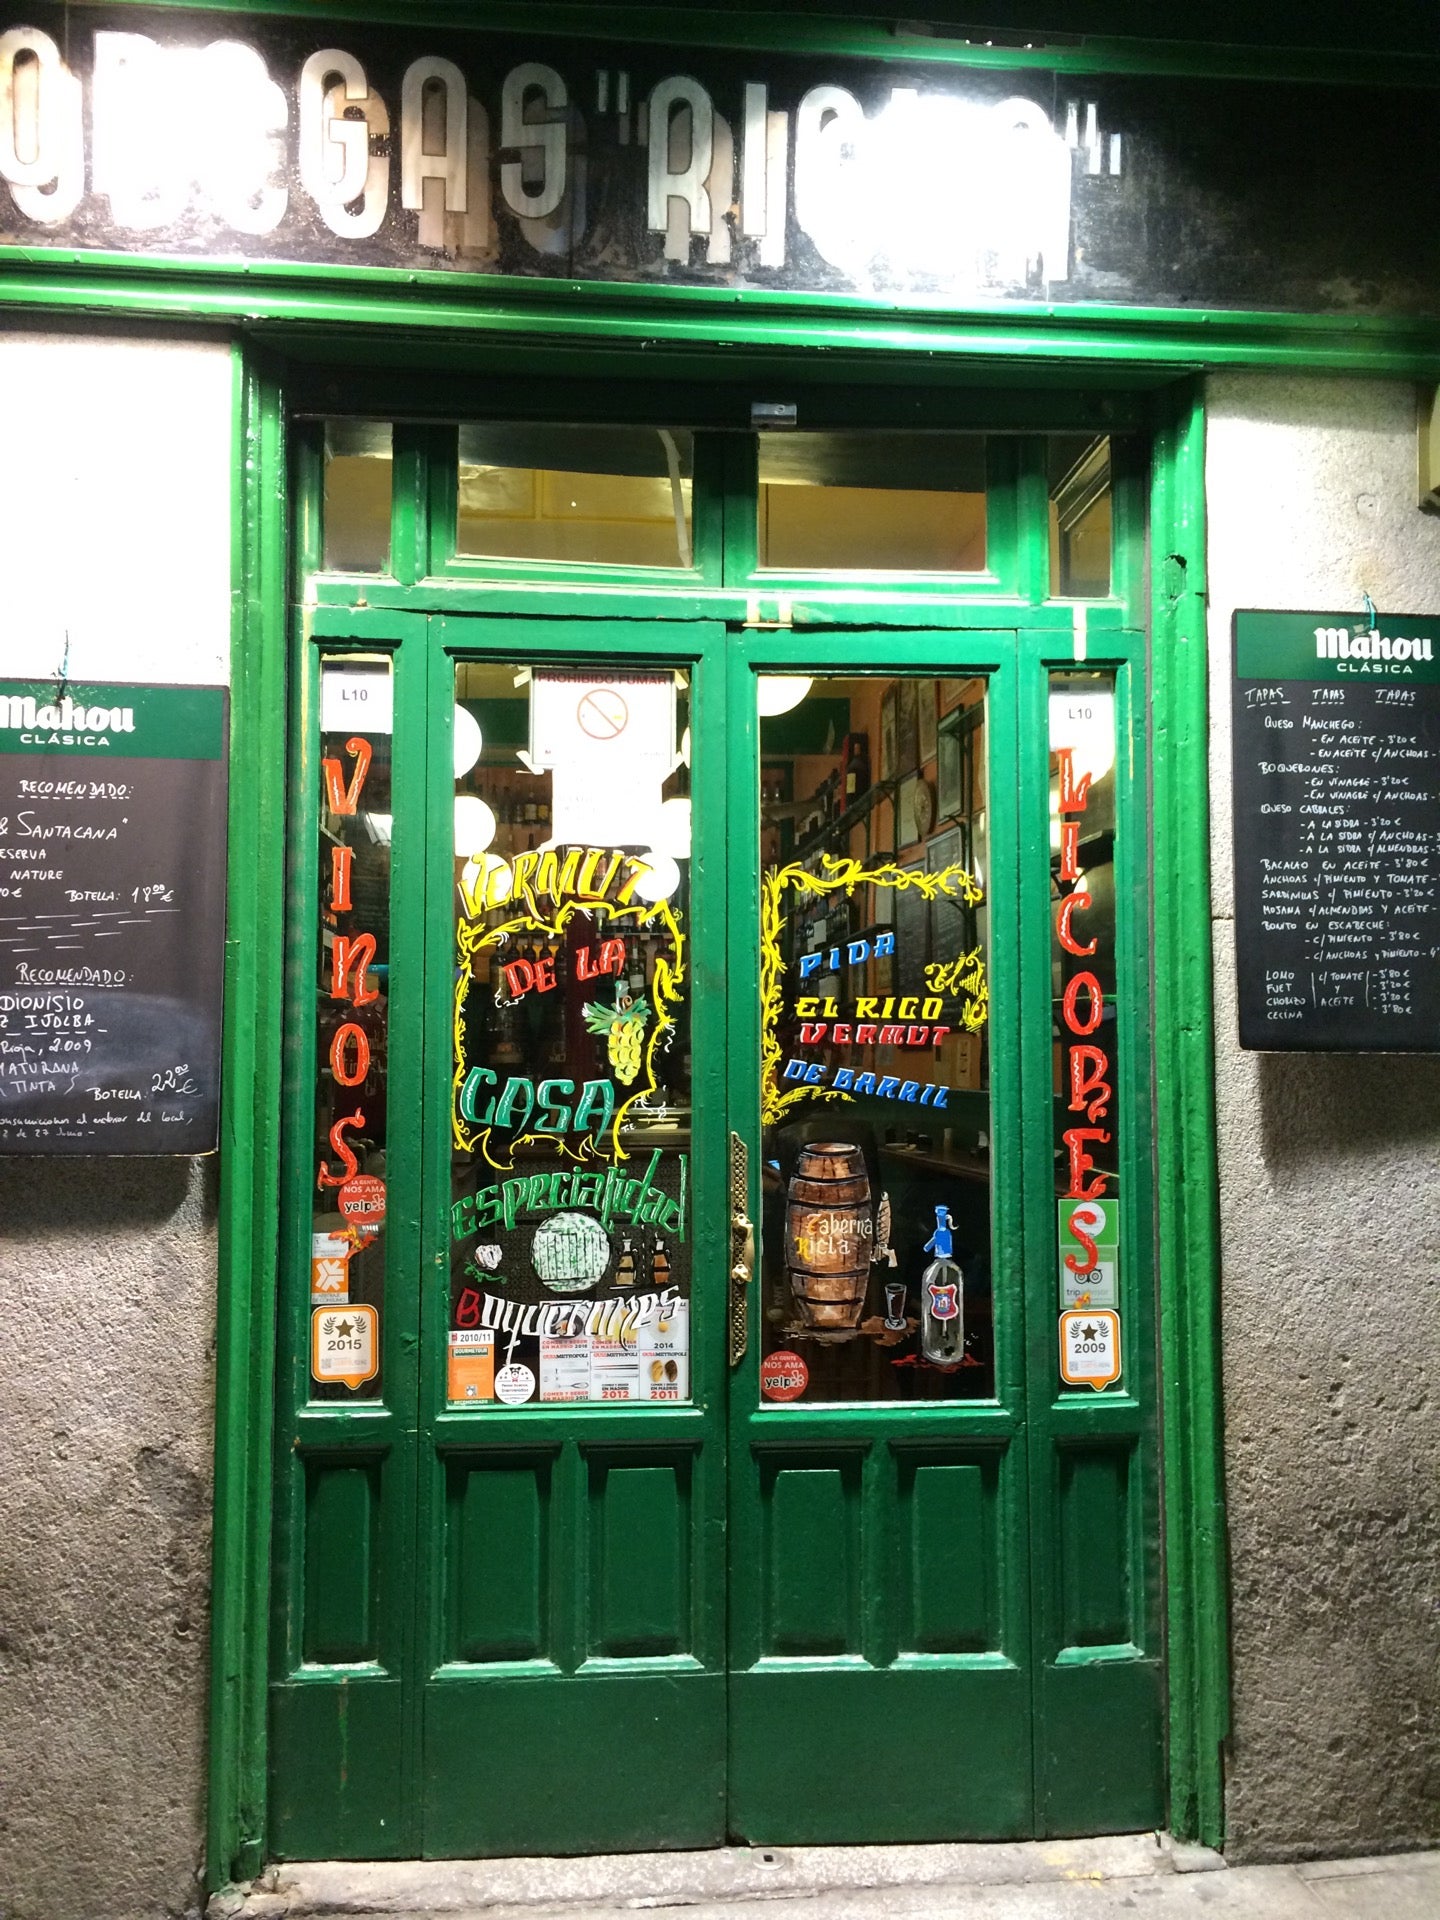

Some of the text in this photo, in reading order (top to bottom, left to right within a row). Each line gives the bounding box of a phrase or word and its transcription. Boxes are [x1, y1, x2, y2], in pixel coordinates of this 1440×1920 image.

[1313, 627, 1434, 662] Mahou
[1336, 661, 1413, 674] CLÁSICA
[537, 672, 667, 685] PROHIBIDO FUMAR
[341, 688, 369, 702] L10
[1244, 687, 1416, 702] TAPAS TAPAS TAPAS
[0, 694, 136, 733] Mahou
[1068, 708, 1093, 720] L10
[1264, 715, 1294, 729] QUESO
[20, 732, 110, 746] CLÁSICA
[1339, 735, 1377, 745] ACEITE
[1260, 803, 1292, 814] QUESO
[10, 870, 64, 880] NATURE
[457, 847, 654, 921] VERMUT
[799, 931, 896, 980] PIDA
[503, 938, 626, 998] DE LA
[1266, 983, 1293, 995] FUET
[0, 990, 85, 1012] DIONISIO
[794, 996, 944, 1020] EL RICO
[800, 1022, 951, 1046] VERMUT
[783, 1058, 950, 1109] DE BARRIL
[460, 1066, 615, 1148] CASA
[343, 1185, 386, 1194] NOS AMA
[344, 1199, 373, 1215] yelp
[806, 1212, 874, 1239] Taberna
[795, 1235, 851, 1262] Ricla
[327, 1339, 362, 1351] 2015
[459, 1333, 491, 1343] 2010/11
[1074, 1342, 1106, 1354] 2009
[764, 1361, 804, 1369] NOS AMA
[765, 1375, 792, 1390] yelp
[601, 1390, 630, 1399] 2012
[650, 1390, 679, 1400] 2011
